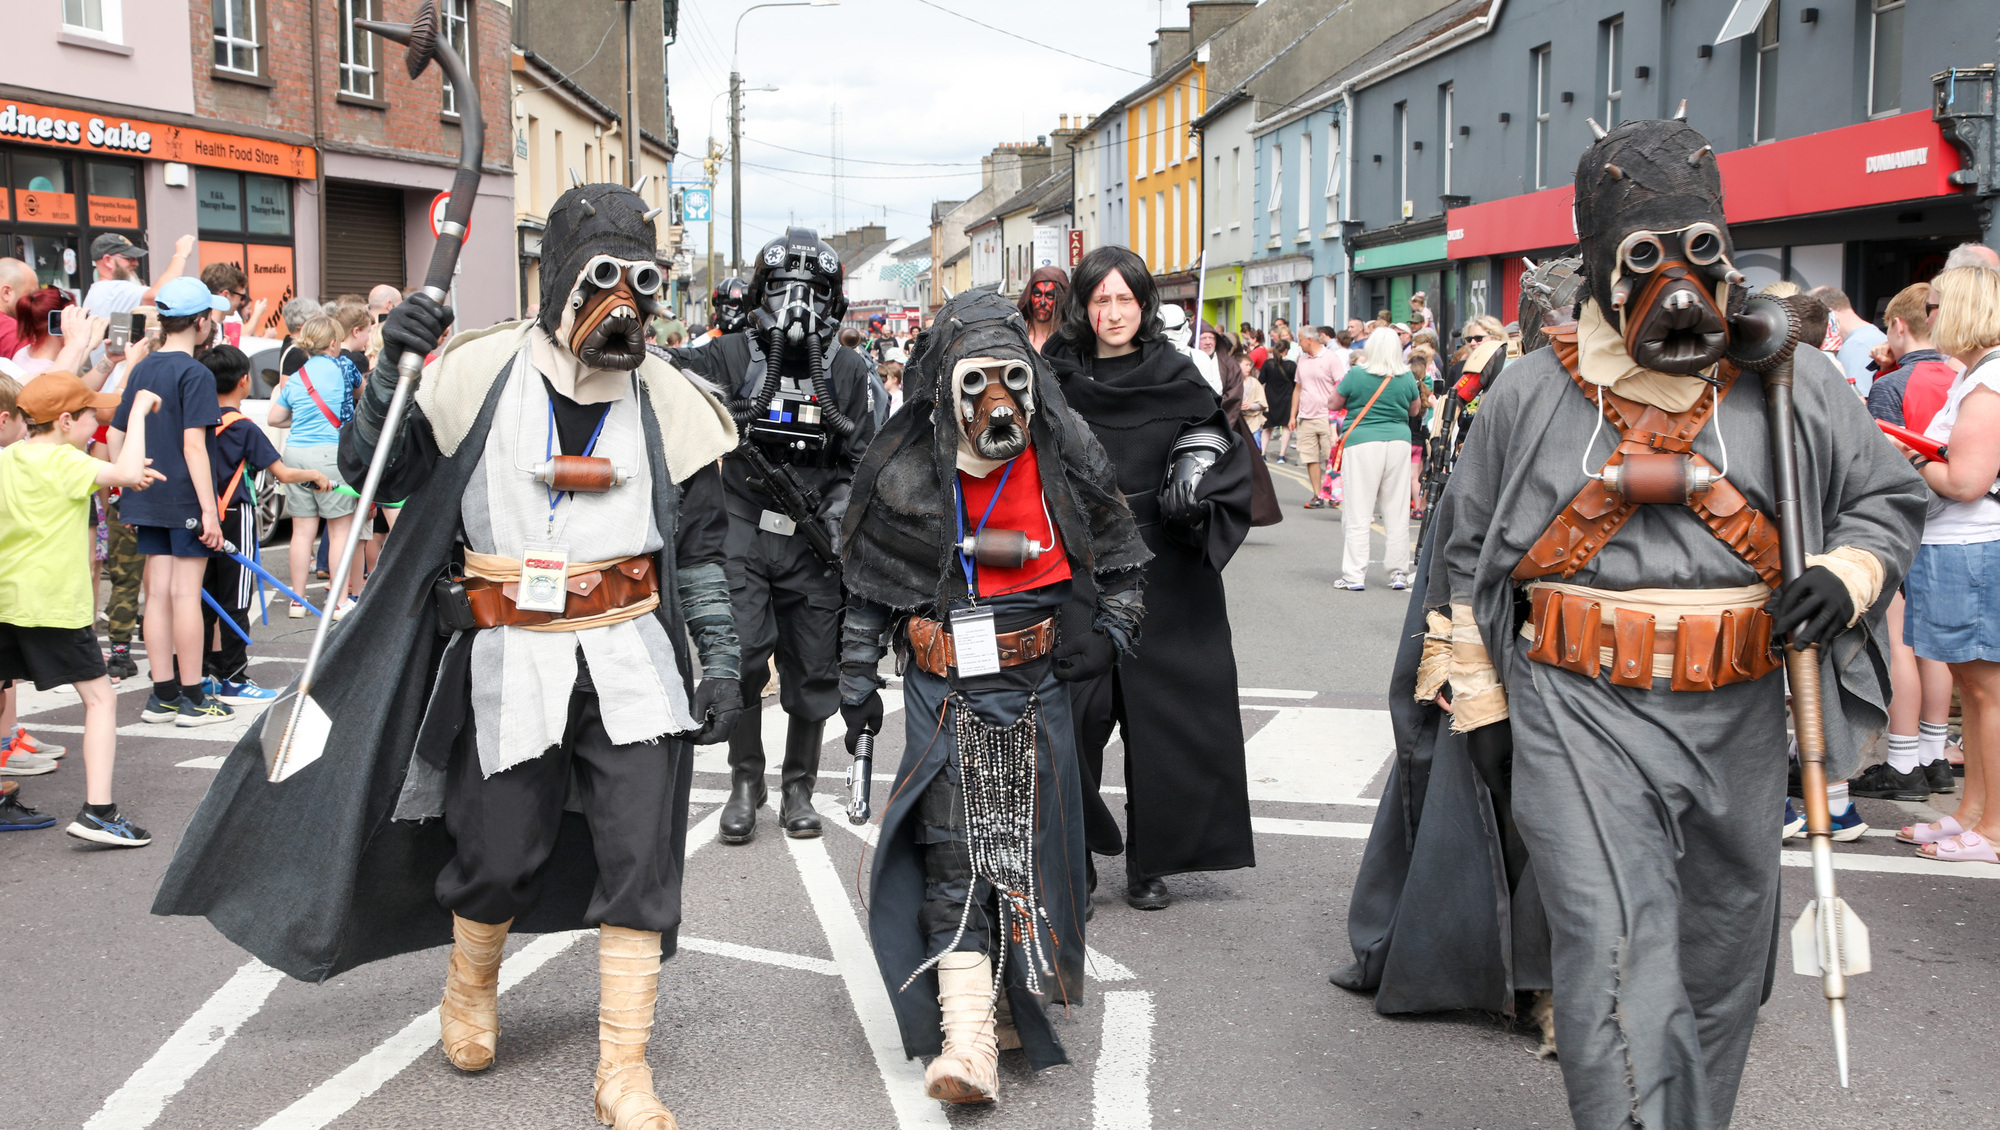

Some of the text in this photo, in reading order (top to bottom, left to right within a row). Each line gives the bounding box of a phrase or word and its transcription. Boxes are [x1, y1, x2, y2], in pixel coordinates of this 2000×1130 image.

[87, 117, 152, 153] Sake
[194, 140, 280, 165] Health Food Store
[1866, 147, 1928, 174] DUNMANWAY
[200, 200, 236, 212] Therapy Room
[251, 205, 285, 216] Therapy Room
[94, 213, 132, 224] Organic Food
[253, 263, 287, 274] Remedies
[525, 558, 565, 570] CREW
